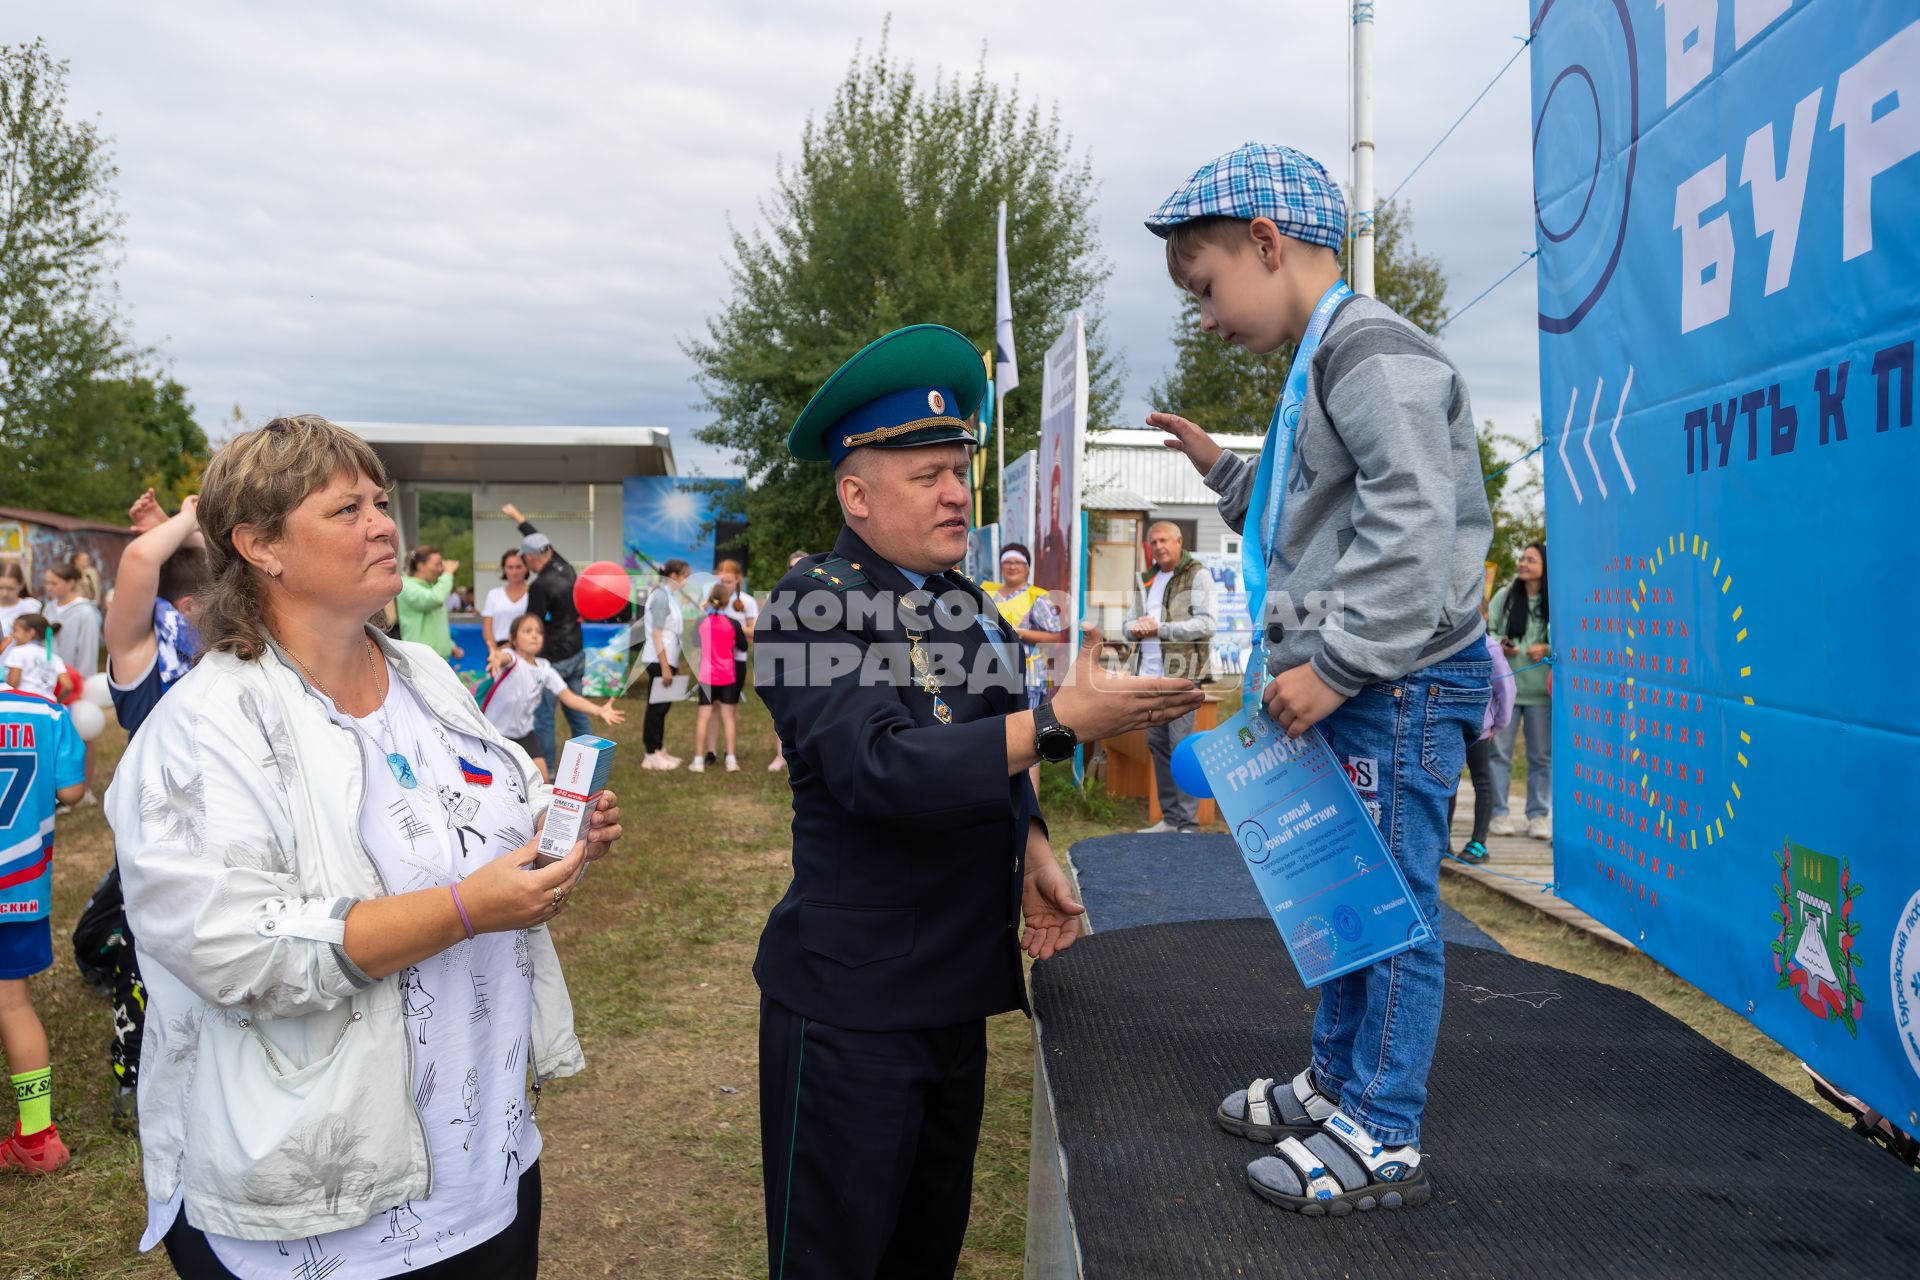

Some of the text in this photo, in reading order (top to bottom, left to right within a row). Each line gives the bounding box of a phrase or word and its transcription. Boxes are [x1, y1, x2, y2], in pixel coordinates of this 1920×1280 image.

[1684, 340, 1915, 475] ПУТЬ К П
[1226, 736, 1308, 792] ГРАМОТА
[1264, 826, 1295, 851] ЮНЫЙ
[1292, 803, 1339, 835] УЧАСТНИК
[1277, 799, 1312, 827] САМЫЙ
